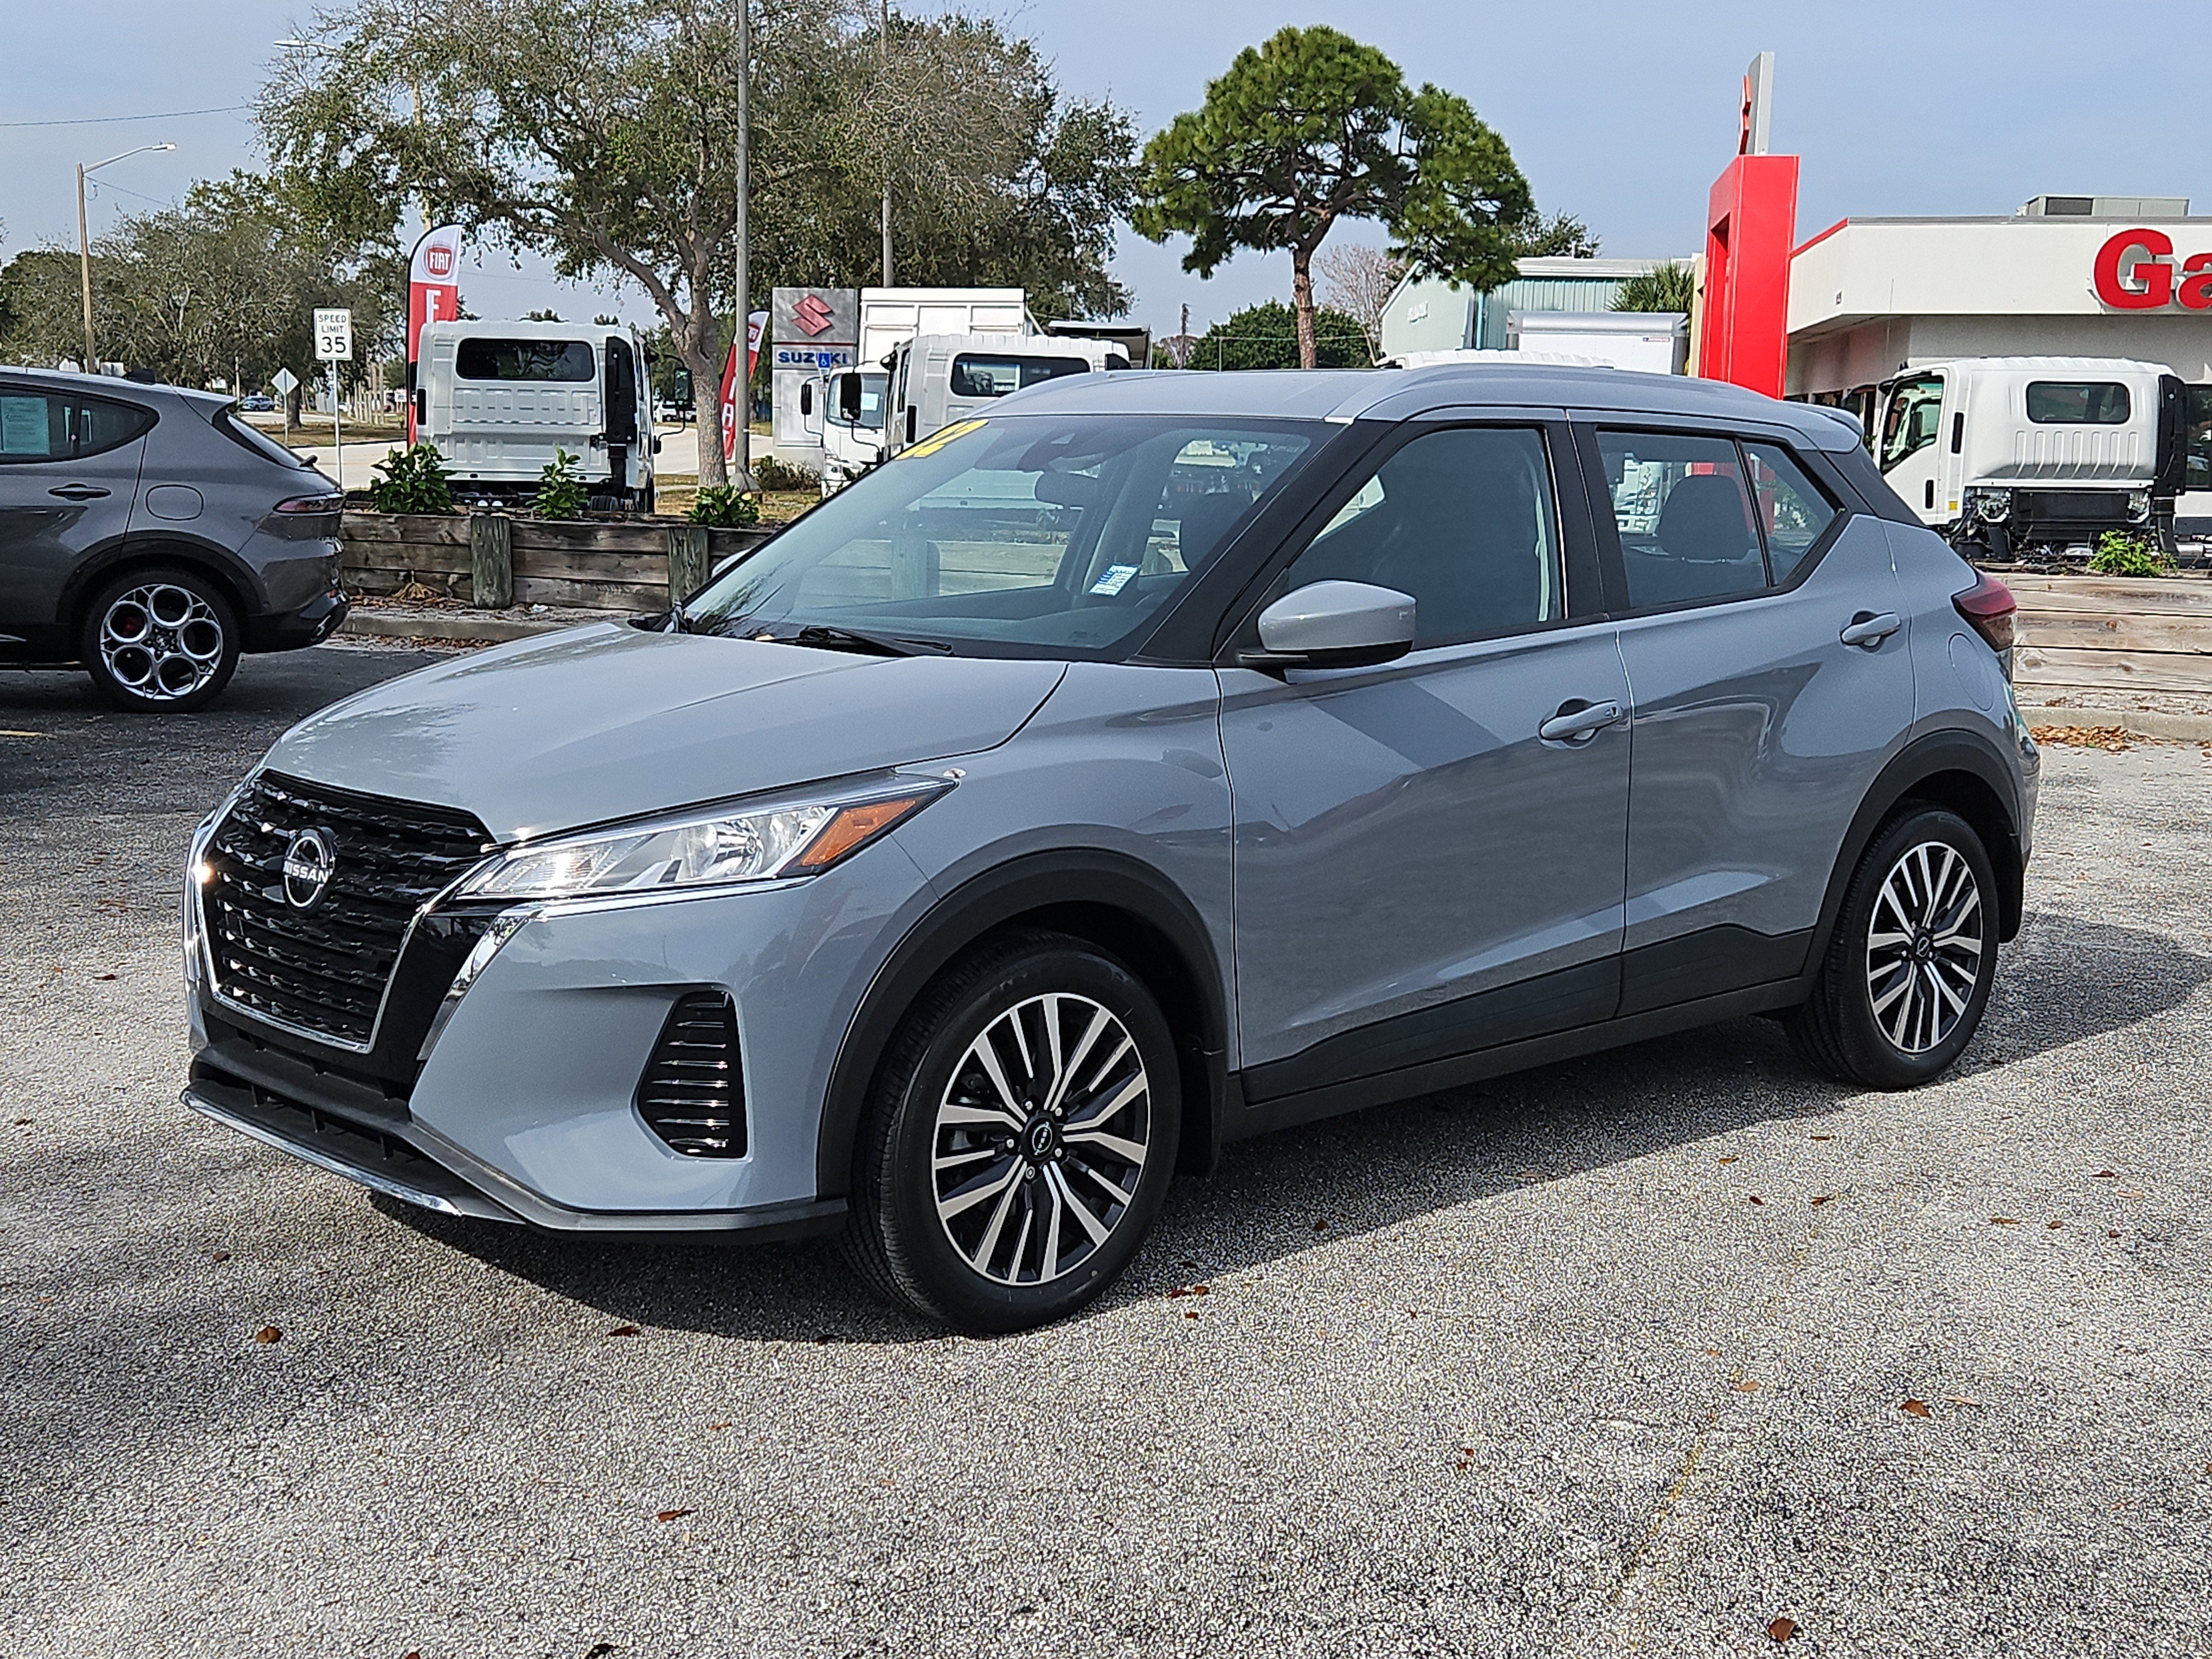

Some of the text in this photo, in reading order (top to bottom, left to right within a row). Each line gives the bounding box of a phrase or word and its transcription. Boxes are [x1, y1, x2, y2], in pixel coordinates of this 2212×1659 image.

[429, 252, 451, 271] FIAT
[318, 314, 346, 323] SPEED
[321, 336, 346, 353] 35
[778, 351, 847, 364] SUZKI
[283, 860, 329, 884] NISSAN
